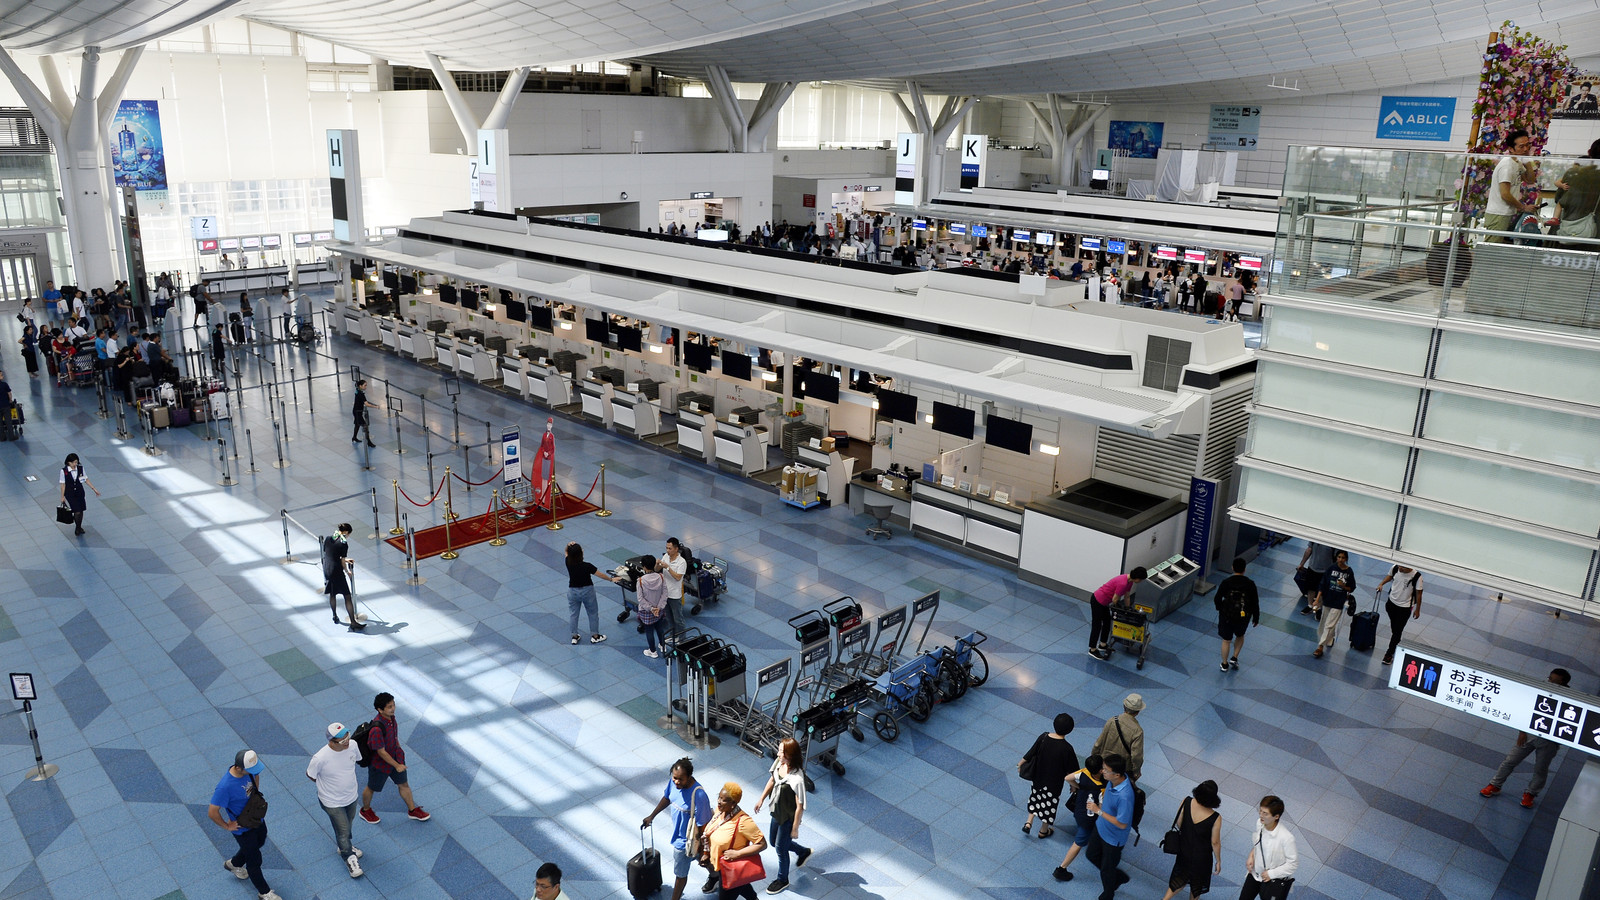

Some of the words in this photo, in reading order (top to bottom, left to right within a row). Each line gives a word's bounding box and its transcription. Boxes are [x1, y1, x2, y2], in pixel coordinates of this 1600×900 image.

[1406, 115, 1448, 125] ABLIC
[330, 138, 341, 167] H
[485, 140, 488, 165] I
[903, 139, 909, 157] J
[966, 140, 977, 157] K
[1100, 154, 1107, 167] L
[471, 162, 477, 179] Z
[202, 219, 209, 228] Z
[1450, 669, 1501, 694] お手洗
[1446, 694, 1474, 708] 洗手间
[1449, 682, 1492, 704] Toilets
[1481, 706, 1512, 721] 화장실
